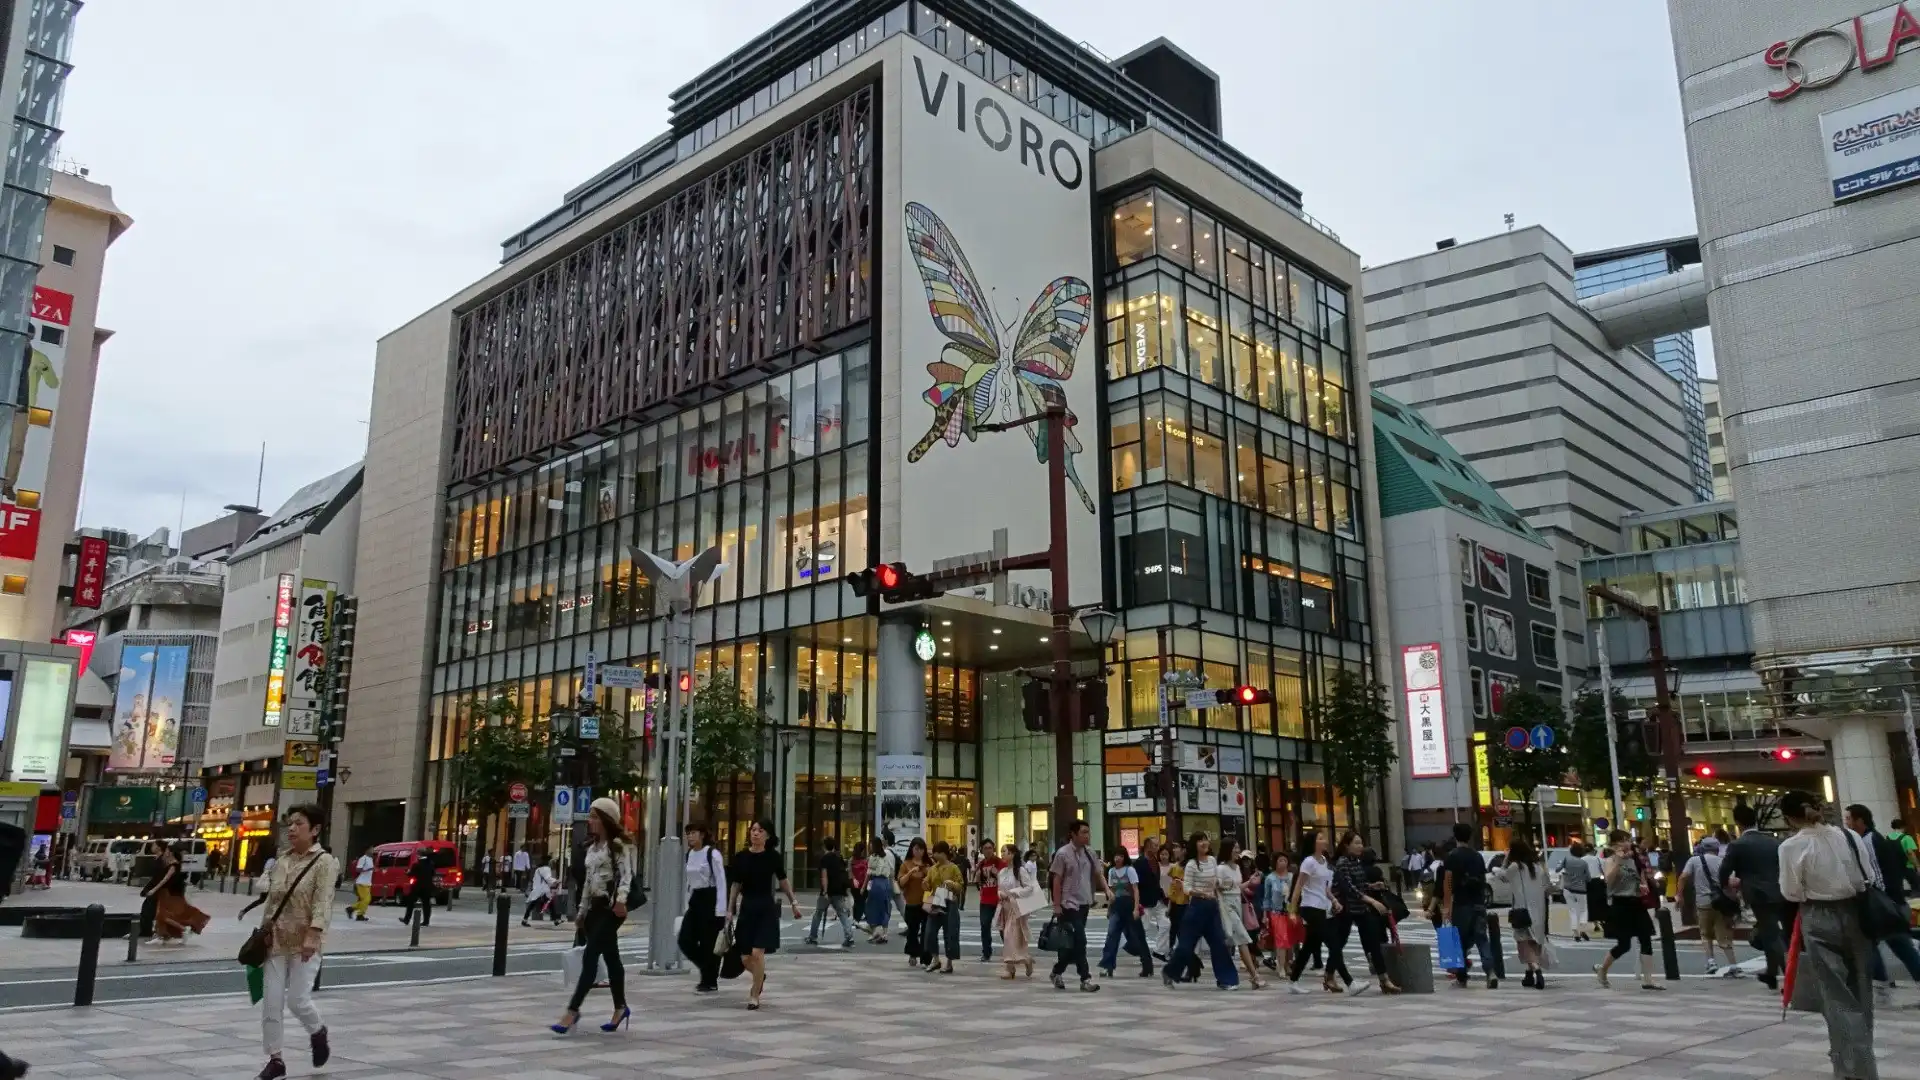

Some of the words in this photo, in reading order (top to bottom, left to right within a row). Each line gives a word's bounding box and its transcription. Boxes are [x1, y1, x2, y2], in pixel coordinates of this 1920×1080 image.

[913, 55, 1083, 190] VIORO
[1844, 140, 1884, 157] CENTRAL
[1888, 130, 1920, 143] SPORT
[1135, 323, 1147, 368] AVEDA
[1144, 564, 1163, 576] SHIPS
[1419, 704, 1434, 742] 大黒屋
